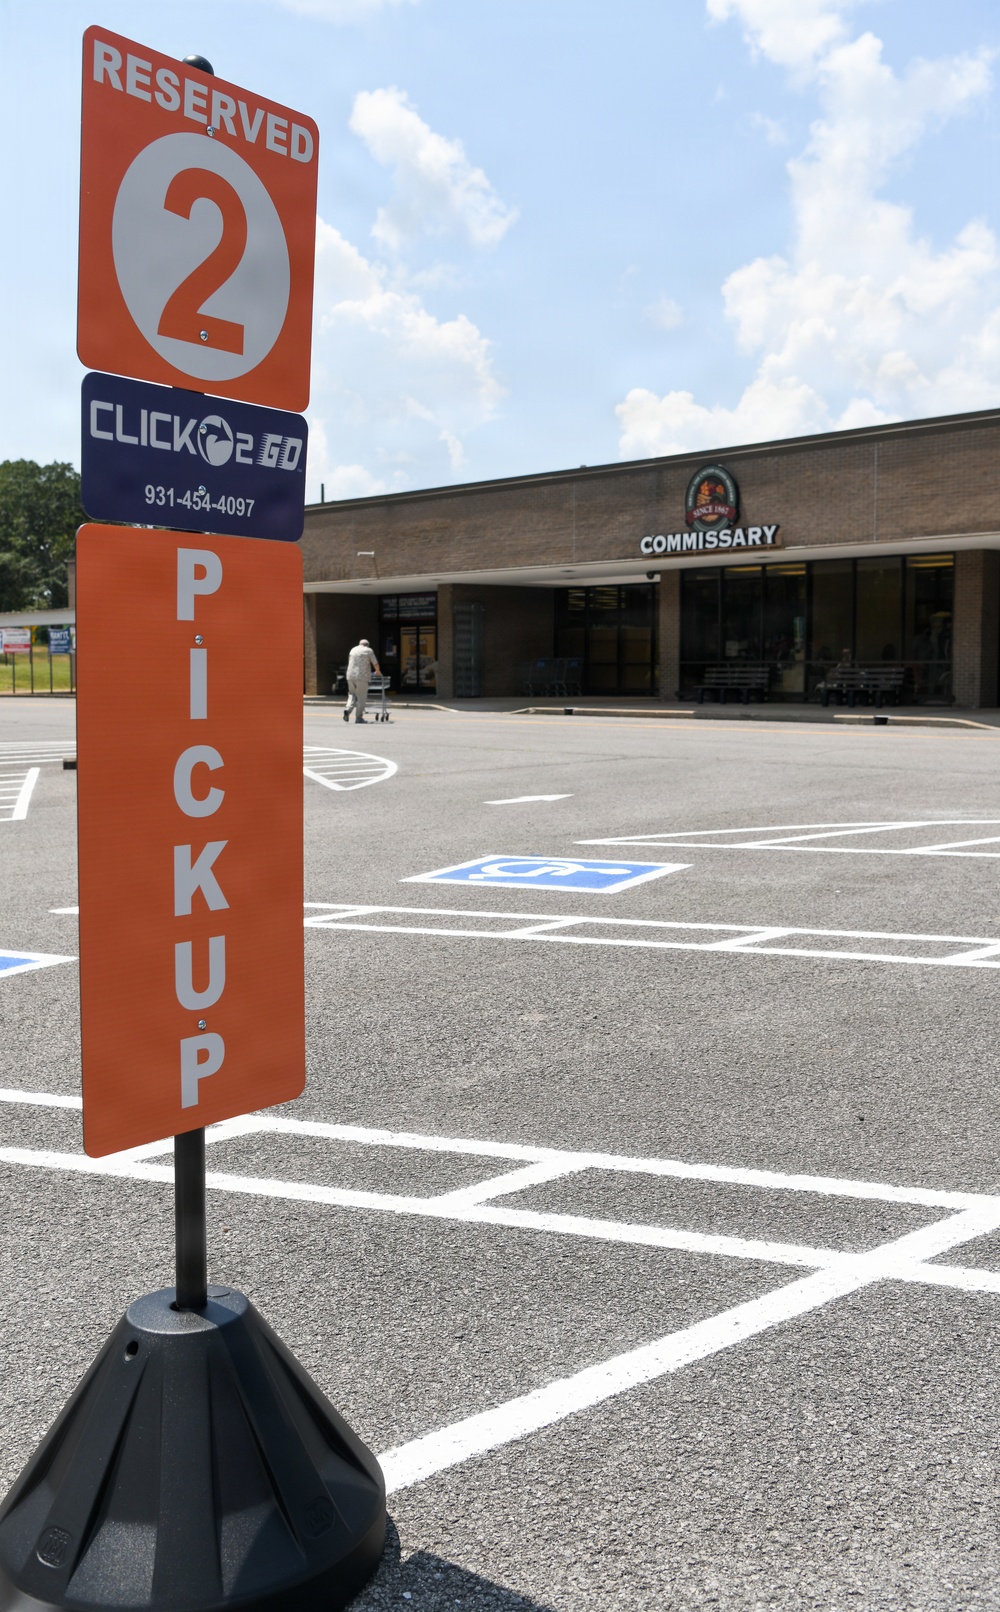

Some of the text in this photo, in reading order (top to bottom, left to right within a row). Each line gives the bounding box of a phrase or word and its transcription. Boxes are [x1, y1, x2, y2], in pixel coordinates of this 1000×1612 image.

[93, 39, 314, 164] RESERVED
[157, 167, 248, 356] 2
[90, 400, 303, 471] CLICK 2 GO
[145, 484, 255, 517] 931-454-4097
[692, 505, 729, 518] SINCE 1867
[640, 525, 777, 555] COMMISSARY
[173, 547, 230, 1109] PICKUP
